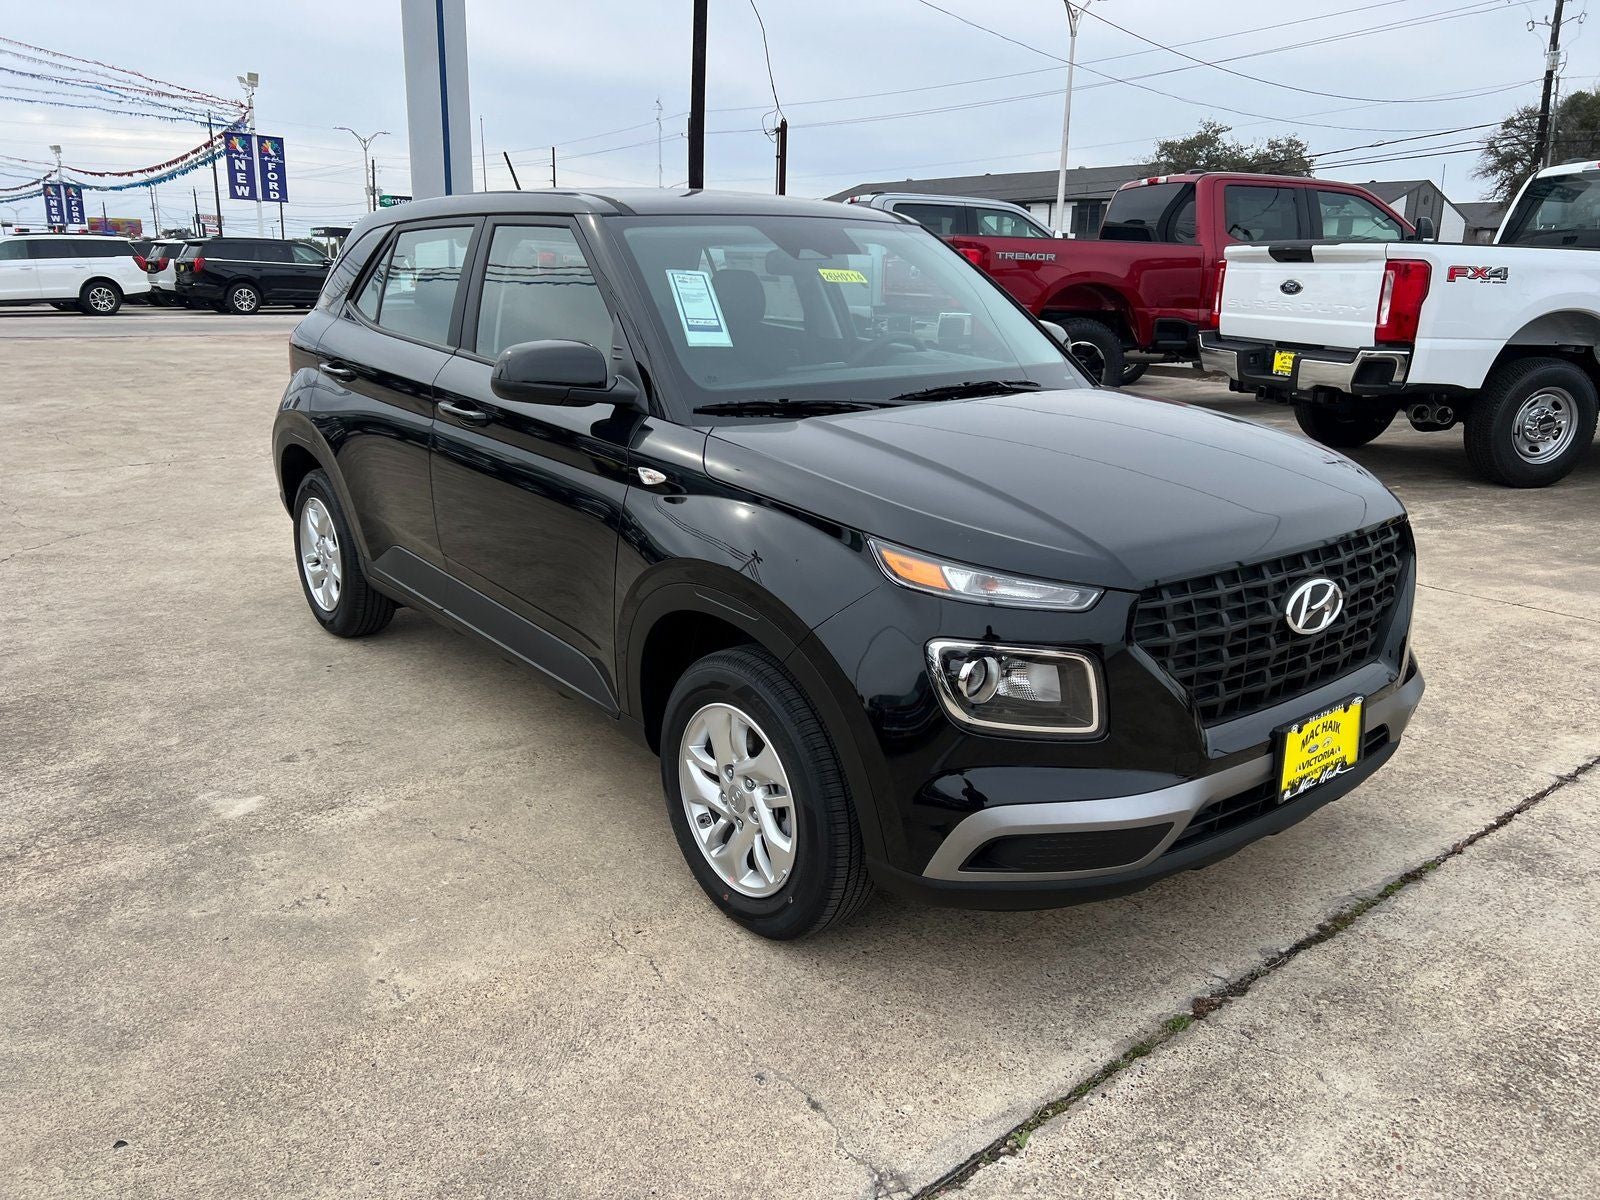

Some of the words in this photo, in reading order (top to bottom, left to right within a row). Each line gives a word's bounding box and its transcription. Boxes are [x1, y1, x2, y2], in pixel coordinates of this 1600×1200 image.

[234, 159, 250, 197] NEW
[267, 162, 280, 200] FORD
[49, 199, 61, 222] NEW
[71, 200, 81, 223] FORD
[995, 251, 1056, 261] TREMOR
[1446, 265, 1509, 282] FX4
[1227, 298, 1292, 311] SUPER
[1300, 302, 1368, 315] DUTY
[1300, 724, 1321, 751] MAC
[1321, 719, 1341, 735] HAIK
